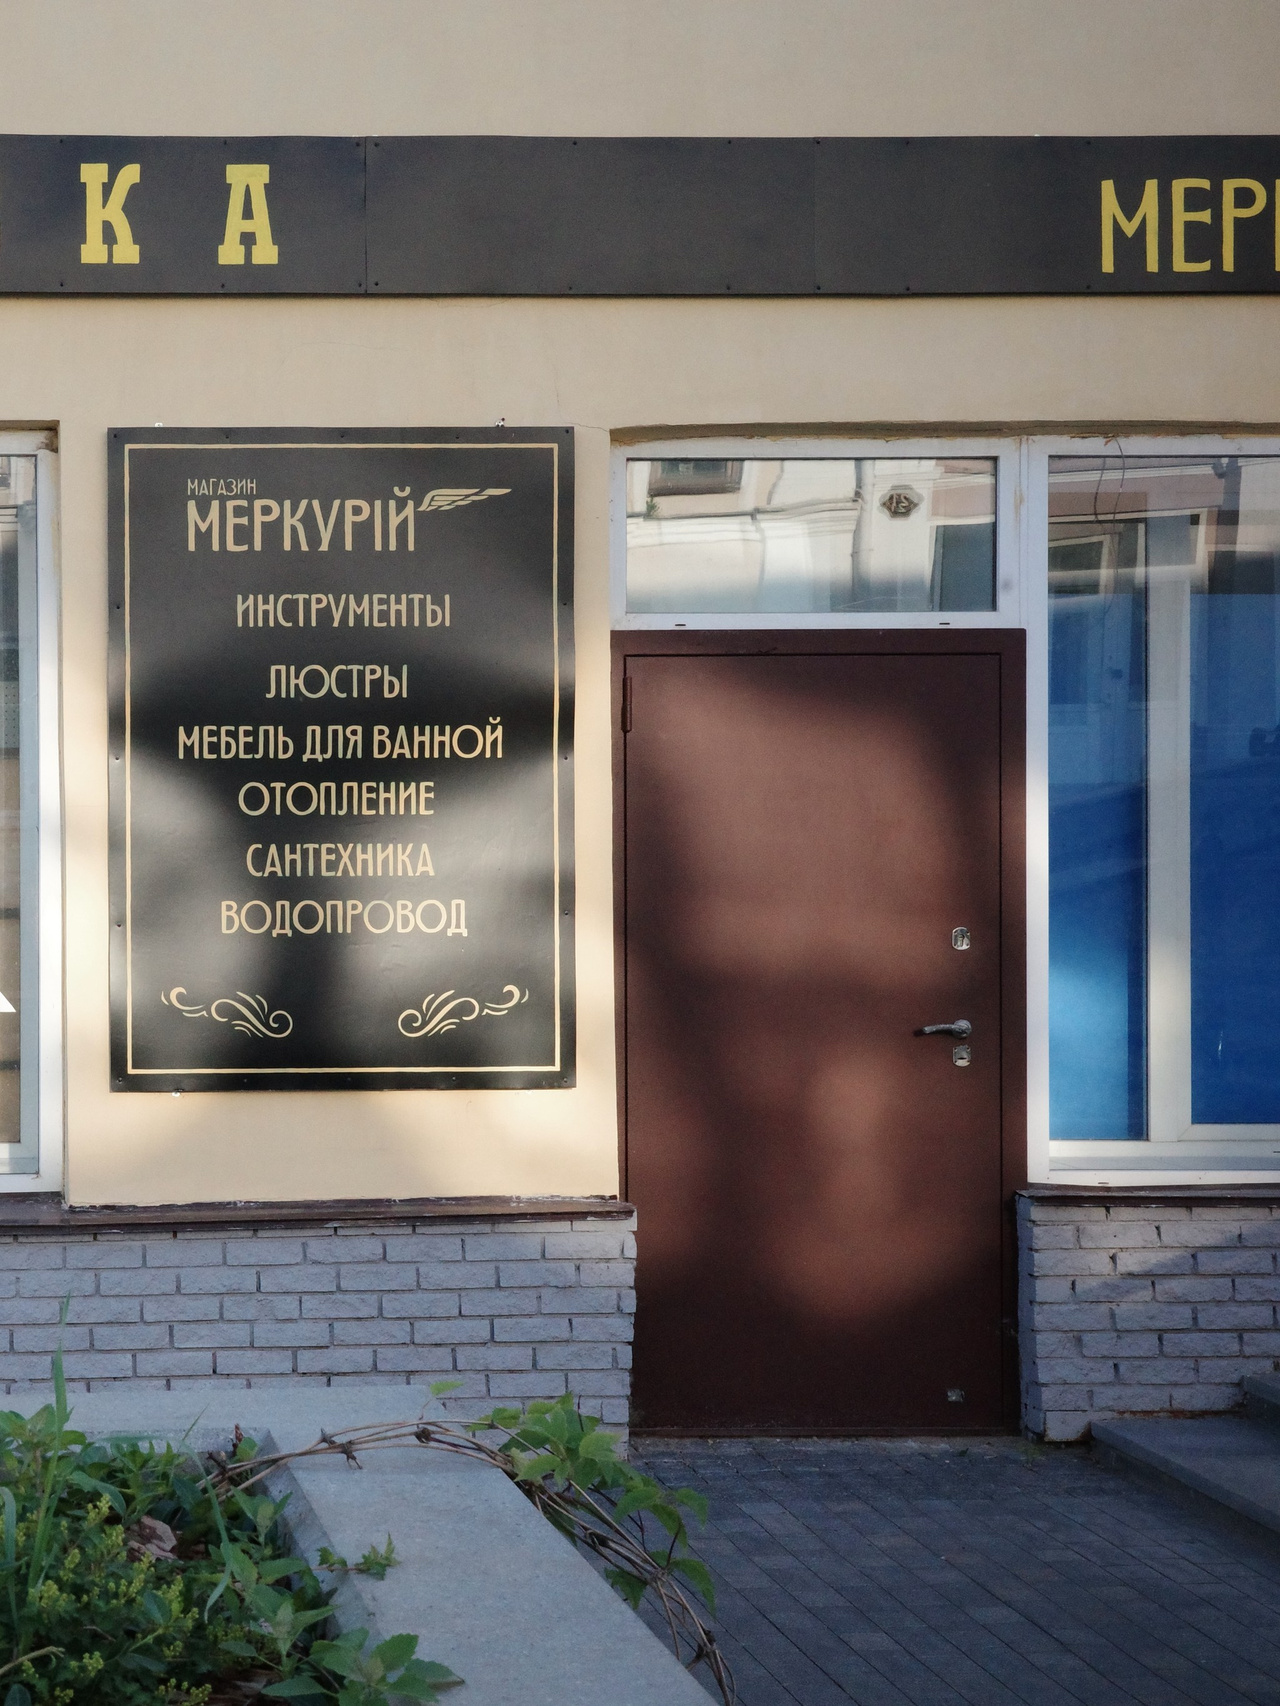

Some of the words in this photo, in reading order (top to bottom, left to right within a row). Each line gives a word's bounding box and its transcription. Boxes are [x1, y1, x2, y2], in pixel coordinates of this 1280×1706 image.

[1100, 177, 1280, 273] МЕР
[186, 478, 257, 496] МАГАЗИН
[187, 486, 415, 551] МЕРКУРІЙ
[236, 594, 451, 628] ИНСТРУМЕНТЫ
[266, 664, 409, 699] ЛЮСТРЫ
[178, 725, 294, 760] МЕБЕЛЬ
[302, 725, 363, 763] ДЛЯ
[373, 717, 504, 760] ВАННОЙ
[238, 781, 435, 816] ОТОПЛЕНИЕ
[246, 843, 435, 877] САНТЕХНИКА
[221, 900, 468, 937] ВОДОПРОВОД
